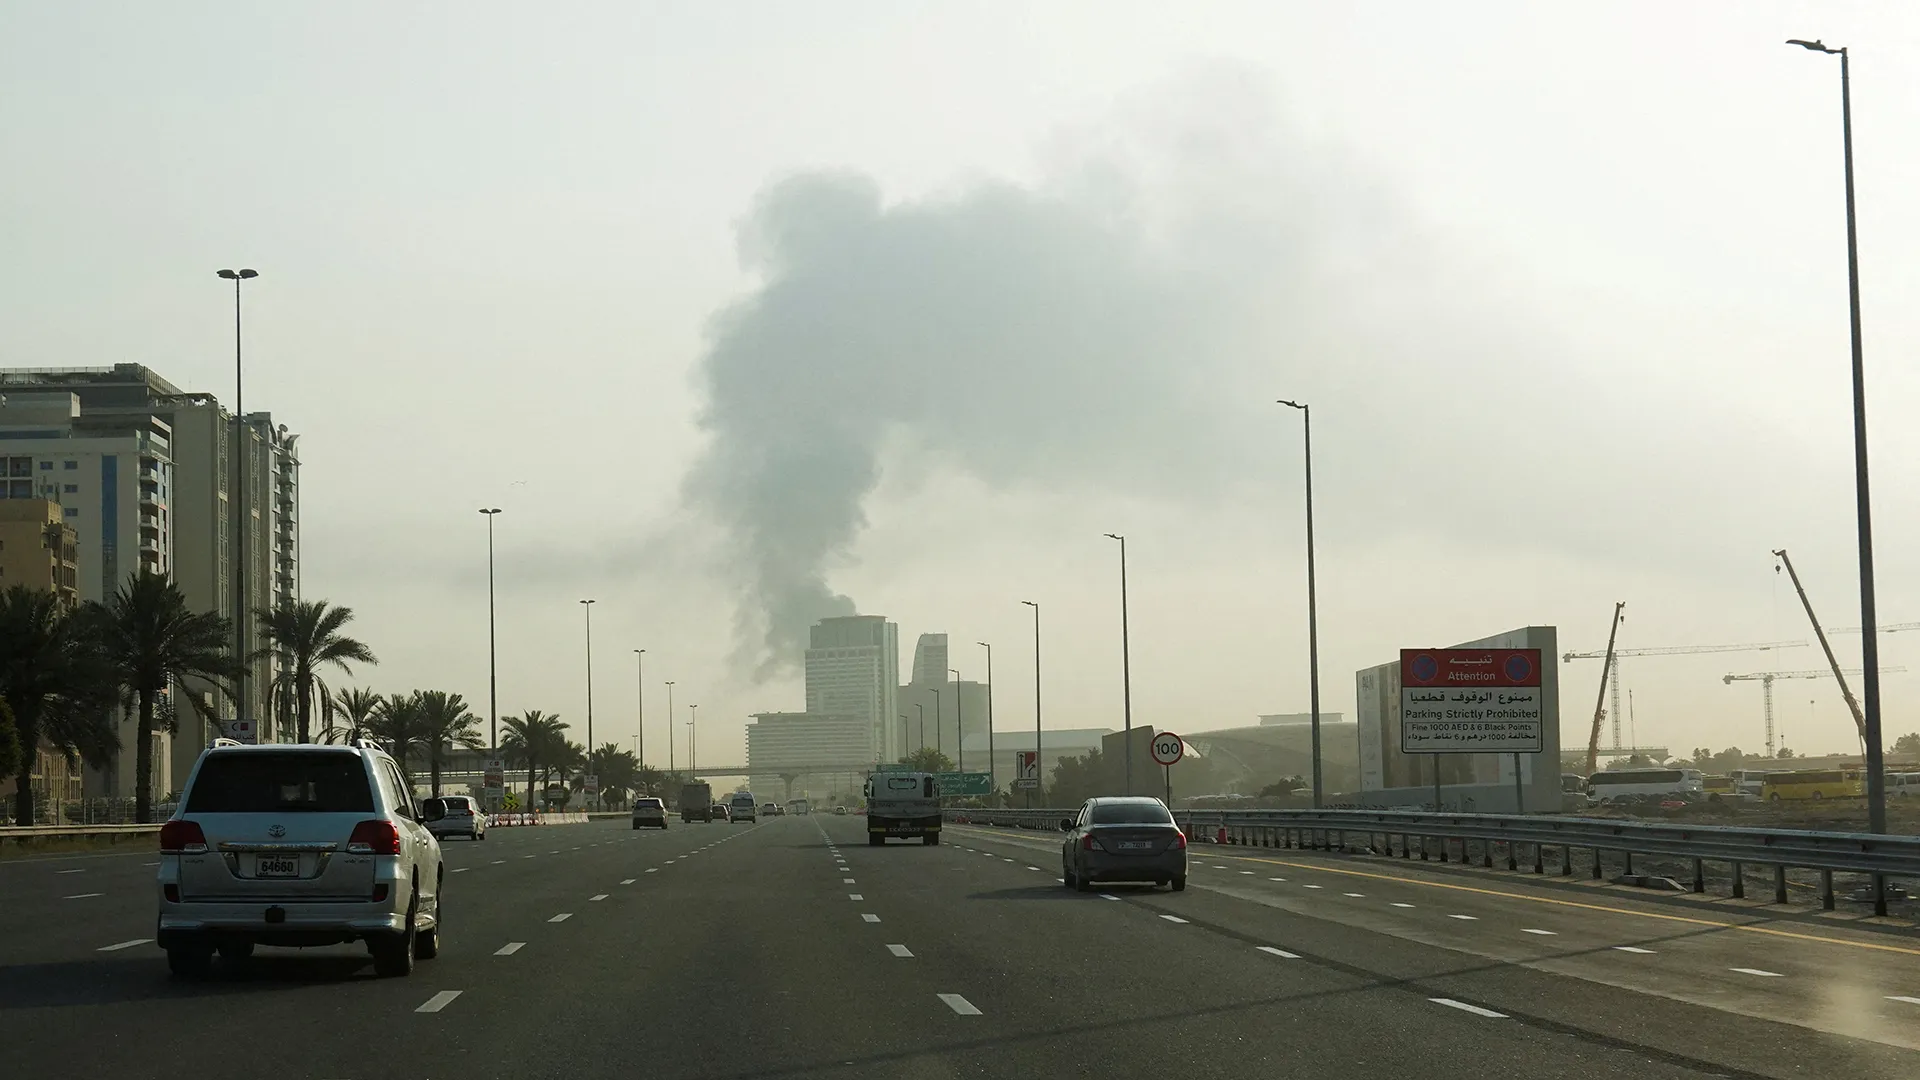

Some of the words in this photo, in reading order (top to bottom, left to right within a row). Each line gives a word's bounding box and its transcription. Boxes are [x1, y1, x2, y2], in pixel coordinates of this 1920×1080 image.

[1449, 655, 1493, 666] تنبيه
[1448, 671, 1496, 681] Attention
[1451, 691, 1492, 704] الوقوف
[1498, 692, 1533, 705] ممنوع
[1405, 709, 1443, 720] Parking
[1446, 709, 1483, 720] Strictly
[1486, 709, 1538, 719] Prohibited
[1411, 723, 1428, 731] Fine
[1430, 723, 1449, 731] 1000
[1451, 723, 1468, 731] AED
[1470, 723, 1475, 731] &
[1477, 723, 1482, 731] 6
[1484, 723, 1505, 731] Black
[1508, 723, 1532, 731] Points
[1408, 733, 1430, 741] سوداء
[1466, 733, 1487, 742] درهم
[1508, 732, 1536, 740] مخالفة
[1155, 742, 1180, 755] 100
